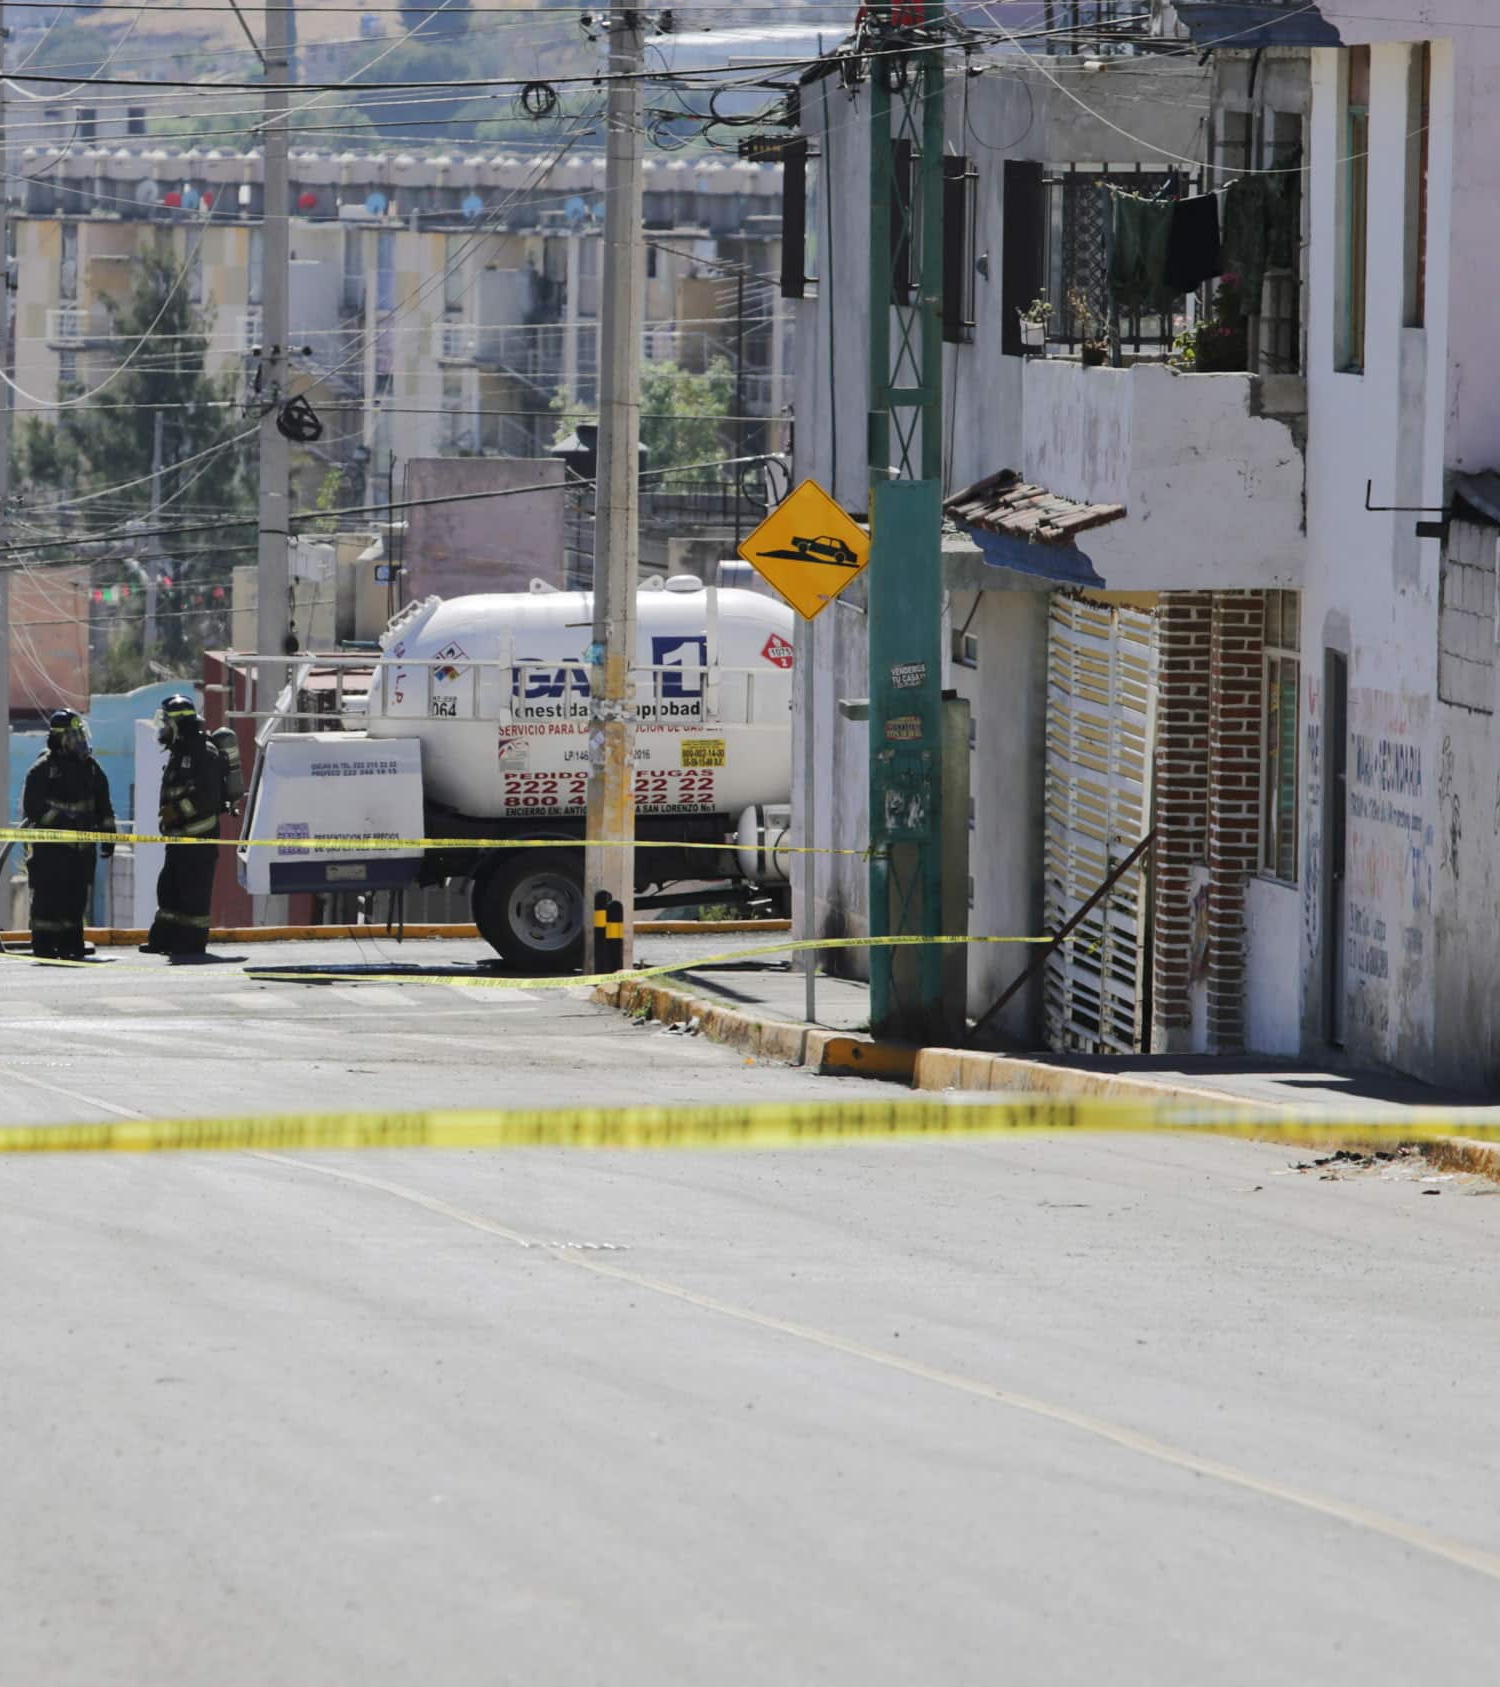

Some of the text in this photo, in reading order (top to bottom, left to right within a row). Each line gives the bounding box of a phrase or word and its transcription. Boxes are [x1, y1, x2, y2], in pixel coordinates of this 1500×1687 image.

[512, 658, 591, 698] GA
[499, 724, 546, 736] SERVICIO
[549, 724, 574, 735] PARA
[504, 769, 714, 780] PEDIDO FUGAS
[505, 781, 558, 794] 222
[504, 796, 558, 807] 800
[661, 803, 699, 812] LORENZO
